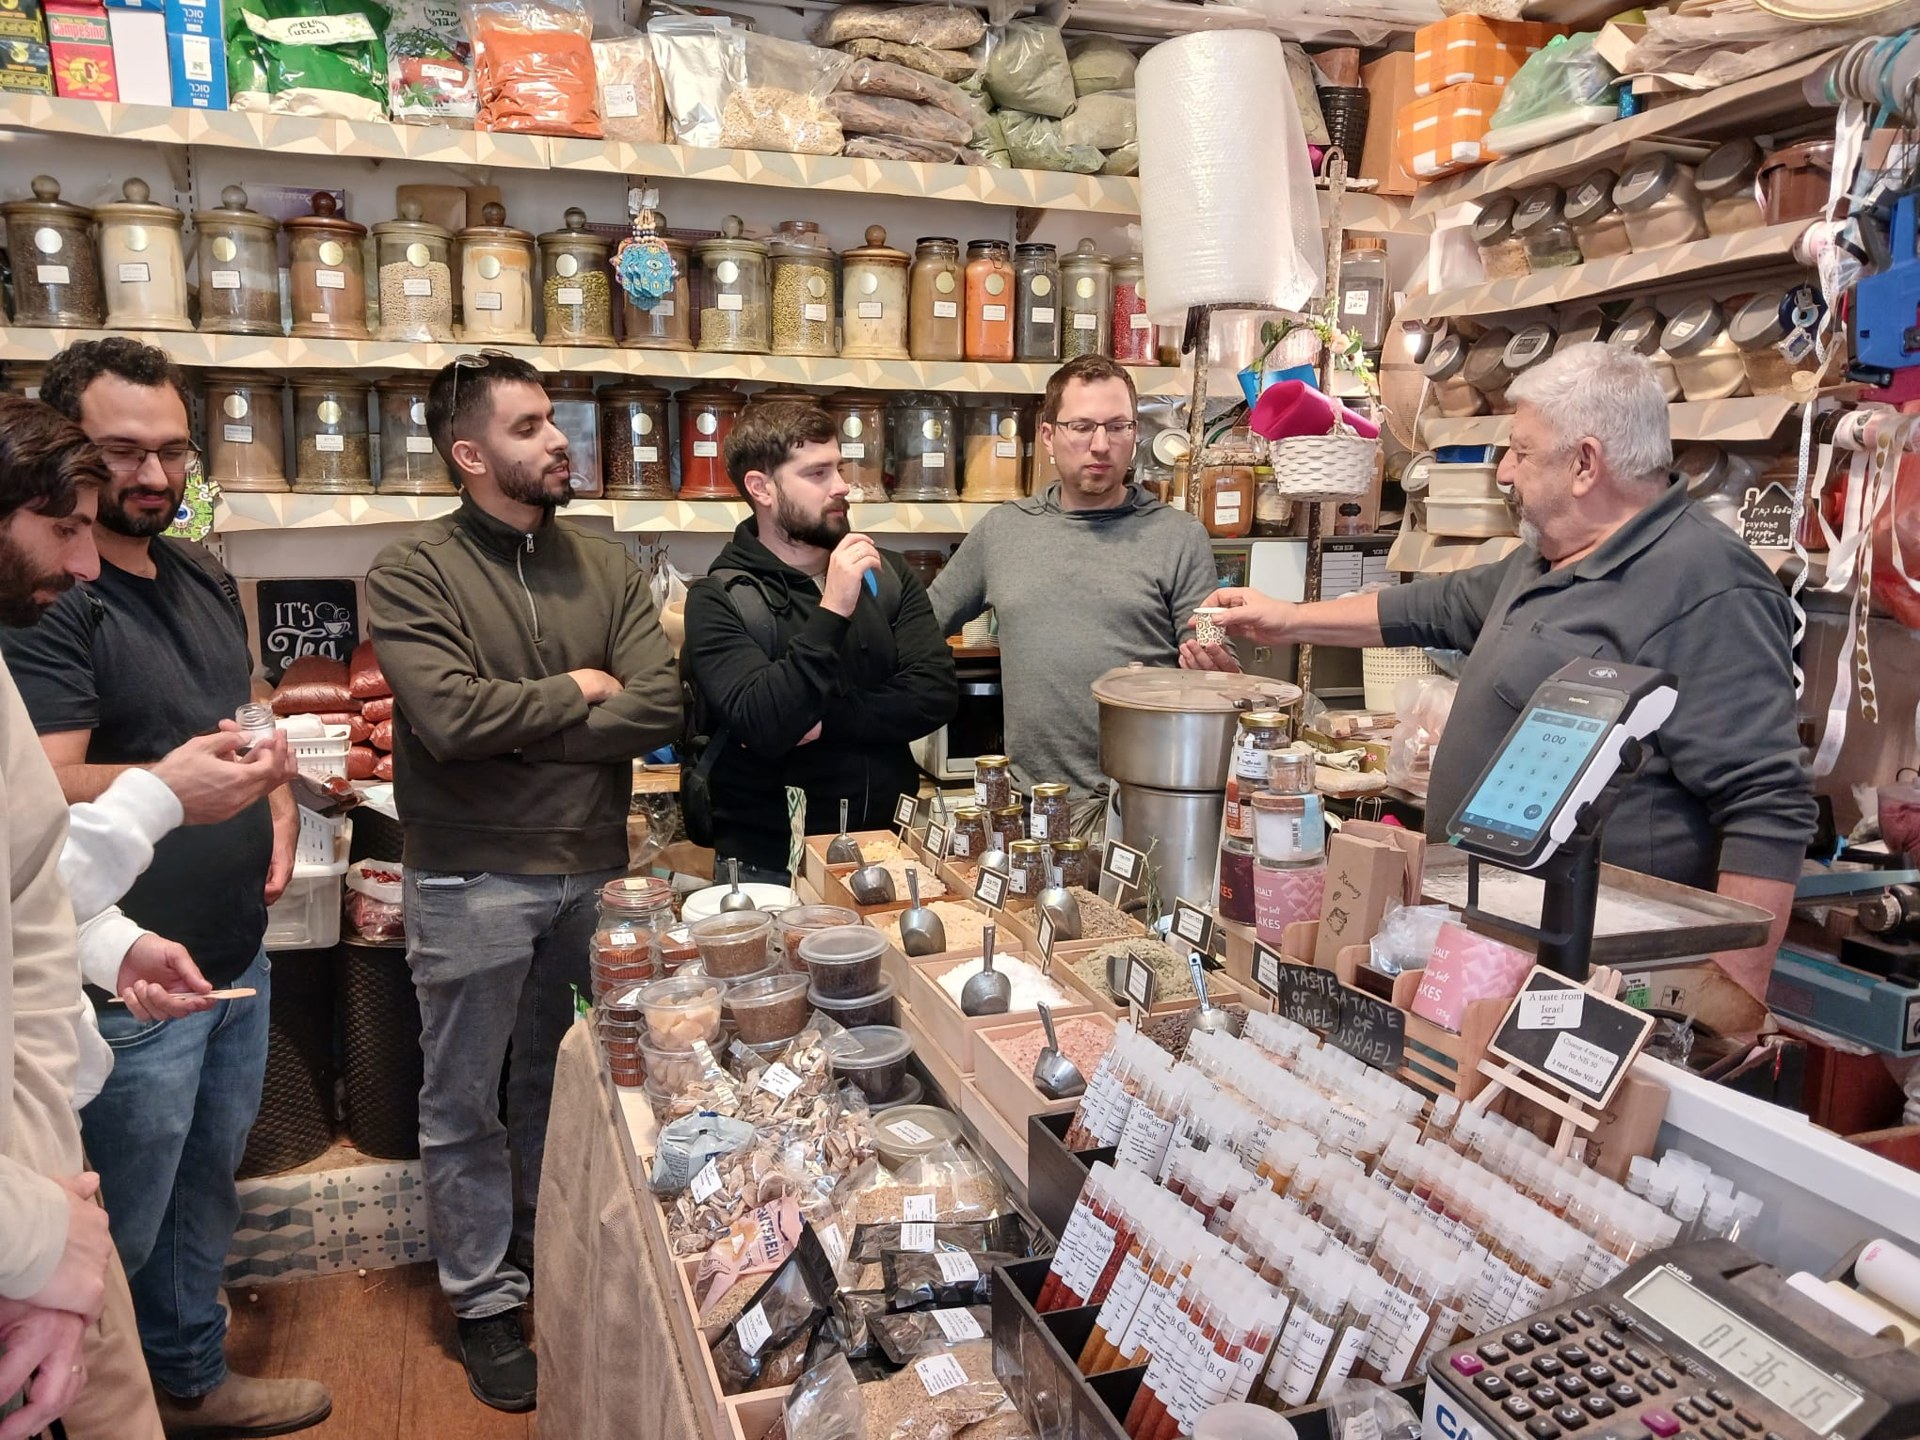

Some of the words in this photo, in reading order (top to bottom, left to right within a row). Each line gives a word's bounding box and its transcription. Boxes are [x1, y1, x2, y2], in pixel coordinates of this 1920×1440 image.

[182, 8, 204, 18] סוכר
[50, 18, 106, 41] Campesino
[189, 83, 210, 93] סוכר
[274, 601, 315, 628] IT'S
[1542, 733, 1567, 745] 0.00
[1257, 919, 1281, 930] AKES
[1279, 966, 1289, 983] A
[1290, 969, 1338, 997] TASTE
[1291, 989, 1311, 1004] OF
[1417, 982, 1443, 1002] AKES
[1529, 992, 1536, 1002] A
[1539, 992, 1559, 1002] taste
[1560, 990, 1583, 1001] from
[1339, 990, 1348, 1007] A
[1350, 996, 1399, 1029] TASTE
[1540, 1004, 1565, 1015] Israel
[1352, 1014, 1374, 1032] OF
[1556, 1061, 1568, 1071] test
[1151, 1118, 1169, 1133] elery
[1665, 1262, 1693, 1283] CASIO
[1523, 1282, 1545, 1300] Spice
[1533, 1322, 1552, 1336] CA
[1566, 1346, 1585, 1357] 7
[1460, 1354, 1475, 1365] C
[1540, 1356, 1557, 1368] 4
[1514, 1367, 1530, 1377] 1
[1590, 1365, 1607, 1376] 8
[1484, 1376, 1500, 1386] 0
[1563, 1376, 1582, 1387] 5
[1536, 1387, 1555, 1398] 2
[1616, 1384, 1633, 1395] 9
[1508, 1396, 1529, 1411] 00
[1589, 1396, 1606, 1407] 6
[1561, 1408, 1580, 1419] 3
